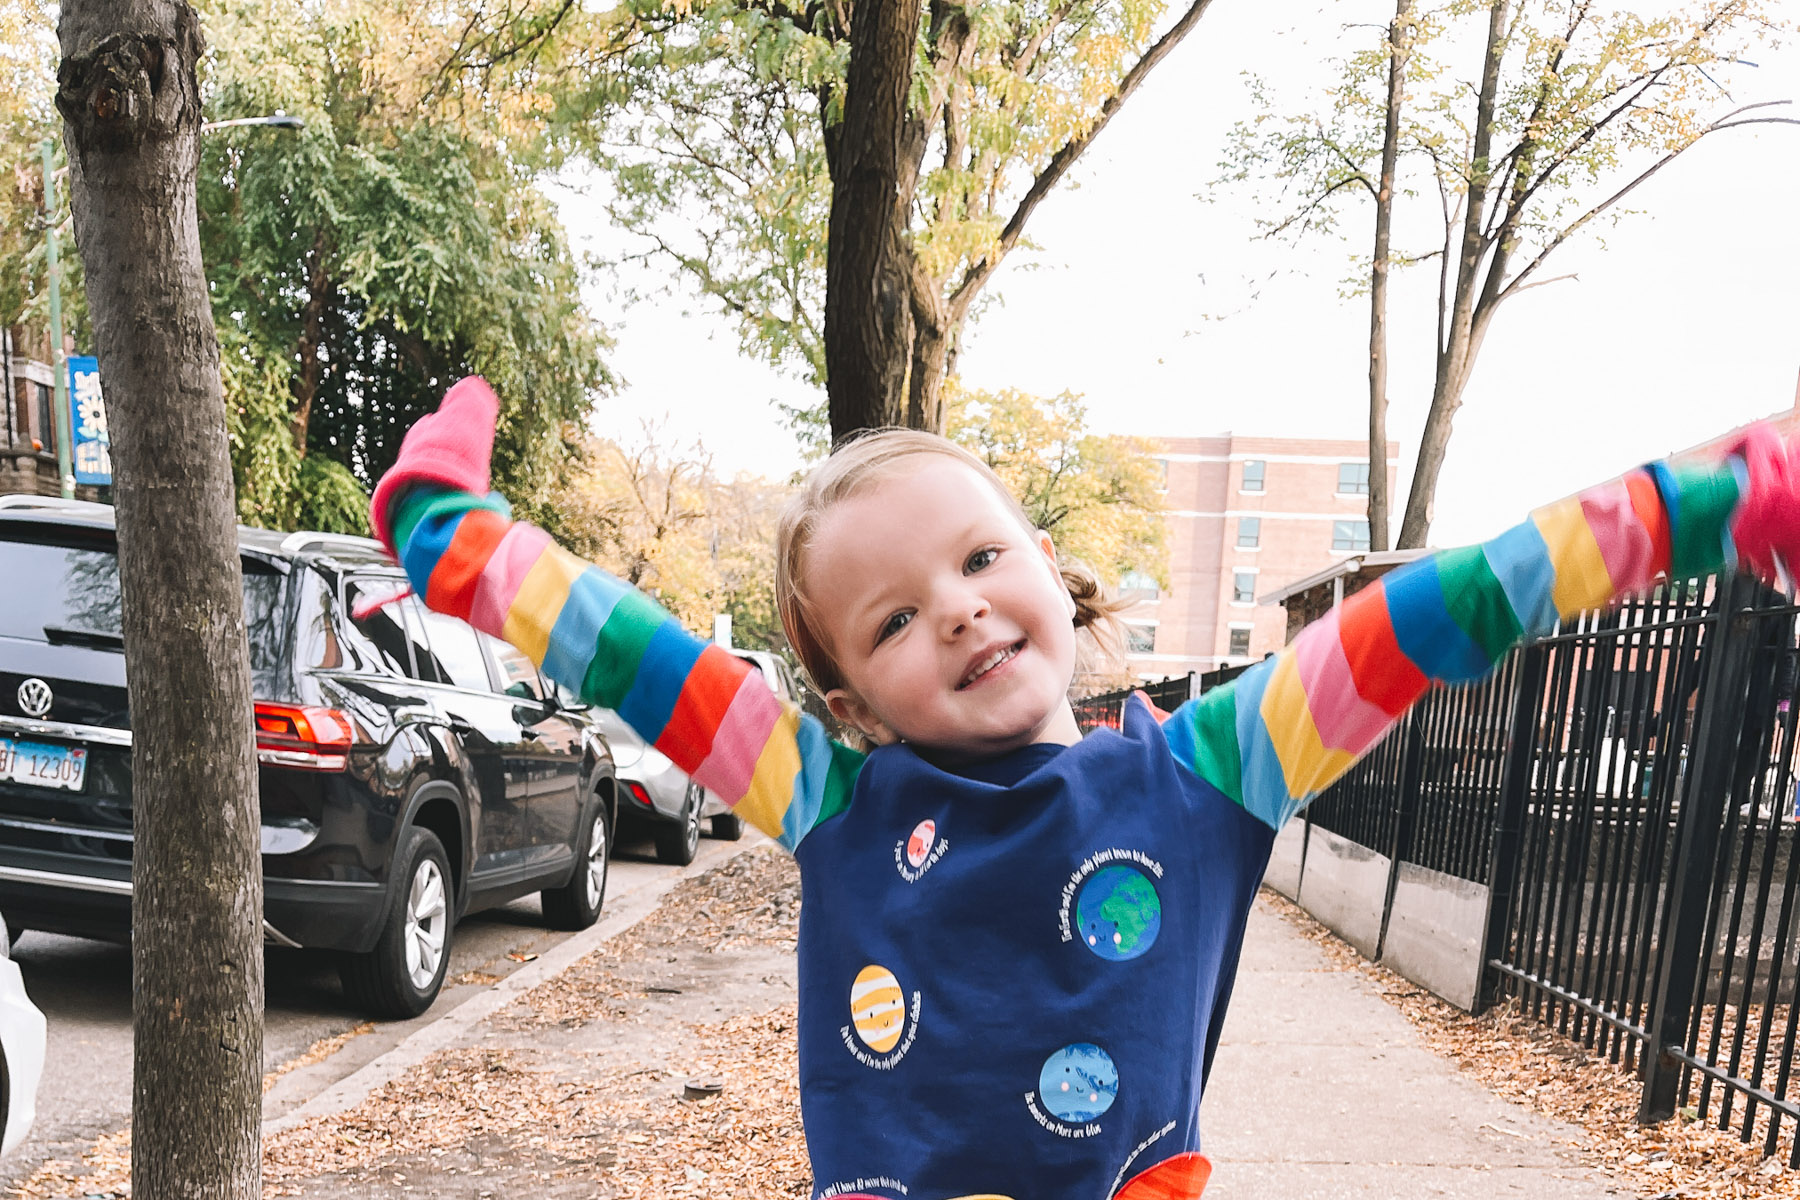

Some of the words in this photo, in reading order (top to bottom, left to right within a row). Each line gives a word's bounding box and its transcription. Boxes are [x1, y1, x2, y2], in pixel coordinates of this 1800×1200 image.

[29, 755, 81, 783] 12309
[1055, 1123, 1072, 1138] Mars
[1073, 1129, 1084, 1138] are
[1085, 1123, 1101, 1137] blue
